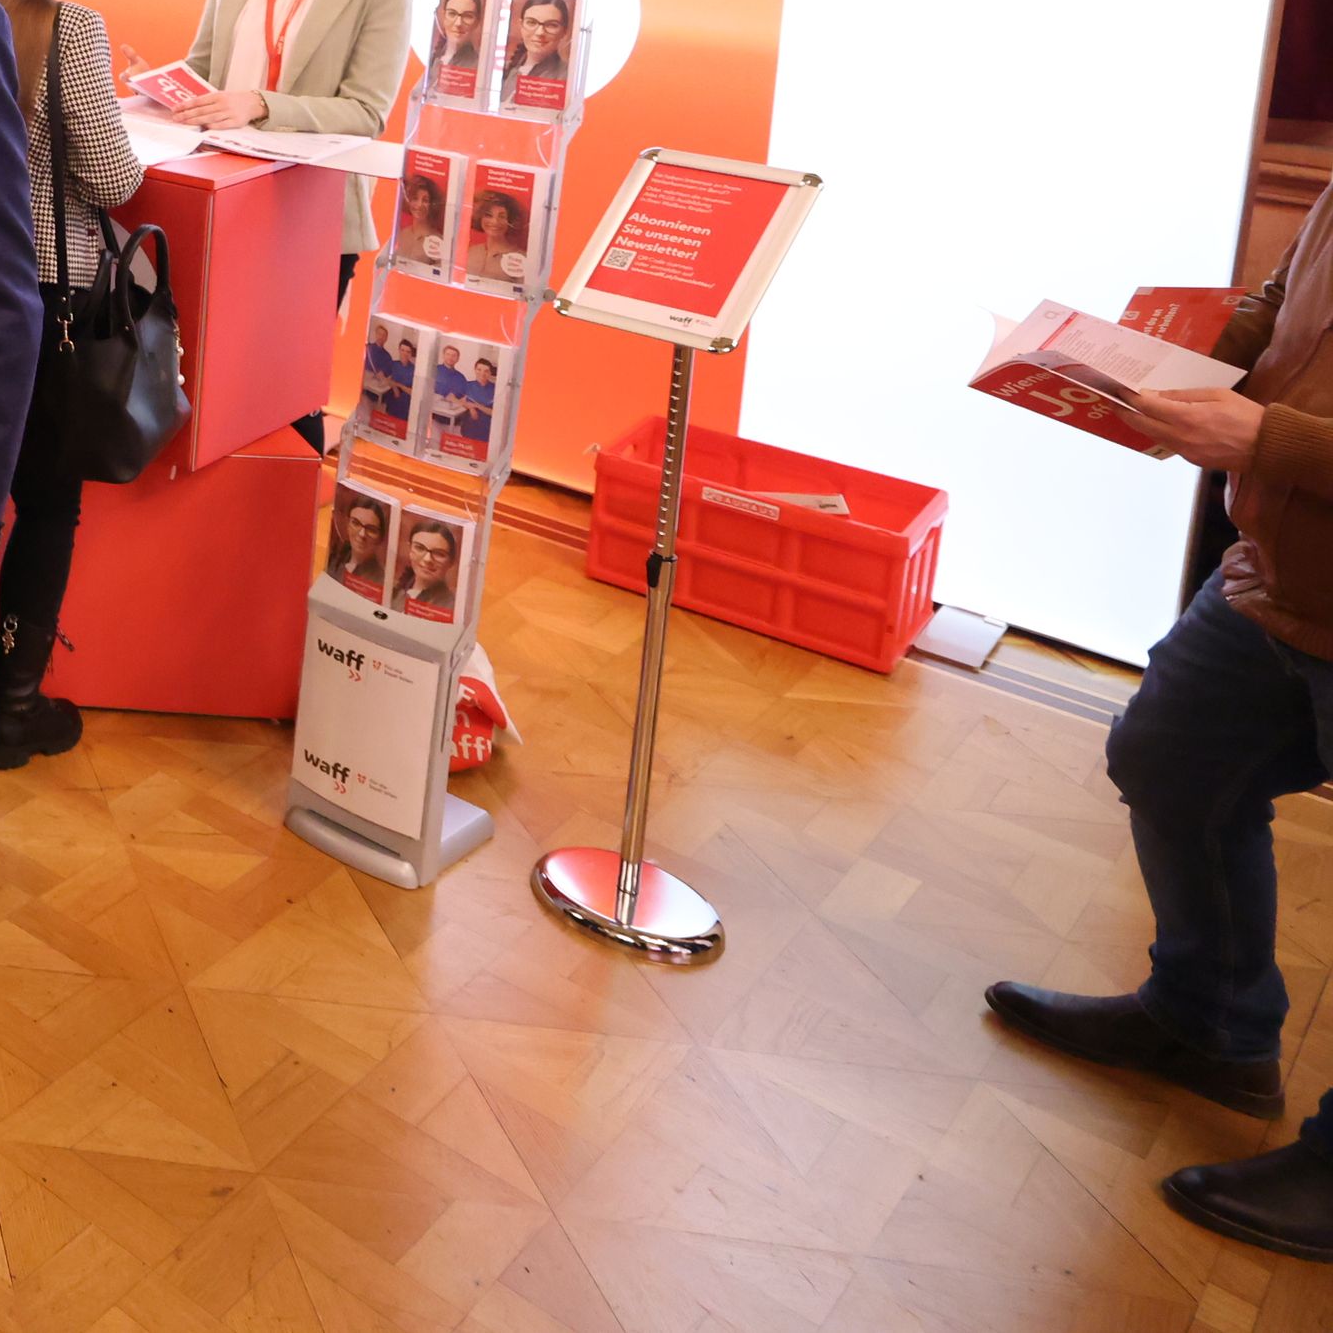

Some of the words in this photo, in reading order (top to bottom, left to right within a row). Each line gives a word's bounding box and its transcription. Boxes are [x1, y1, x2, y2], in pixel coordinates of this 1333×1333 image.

[621, 223, 643, 237] Sie
[644, 230, 702, 248] unseren
[628, 212, 712, 236] Abonnieren
[614, 235, 699, 260] Newsletter!
[669, 314, 693, 325] waff
[317, 638, 366, 672] waff
[303, 748, 351, 784] waff
